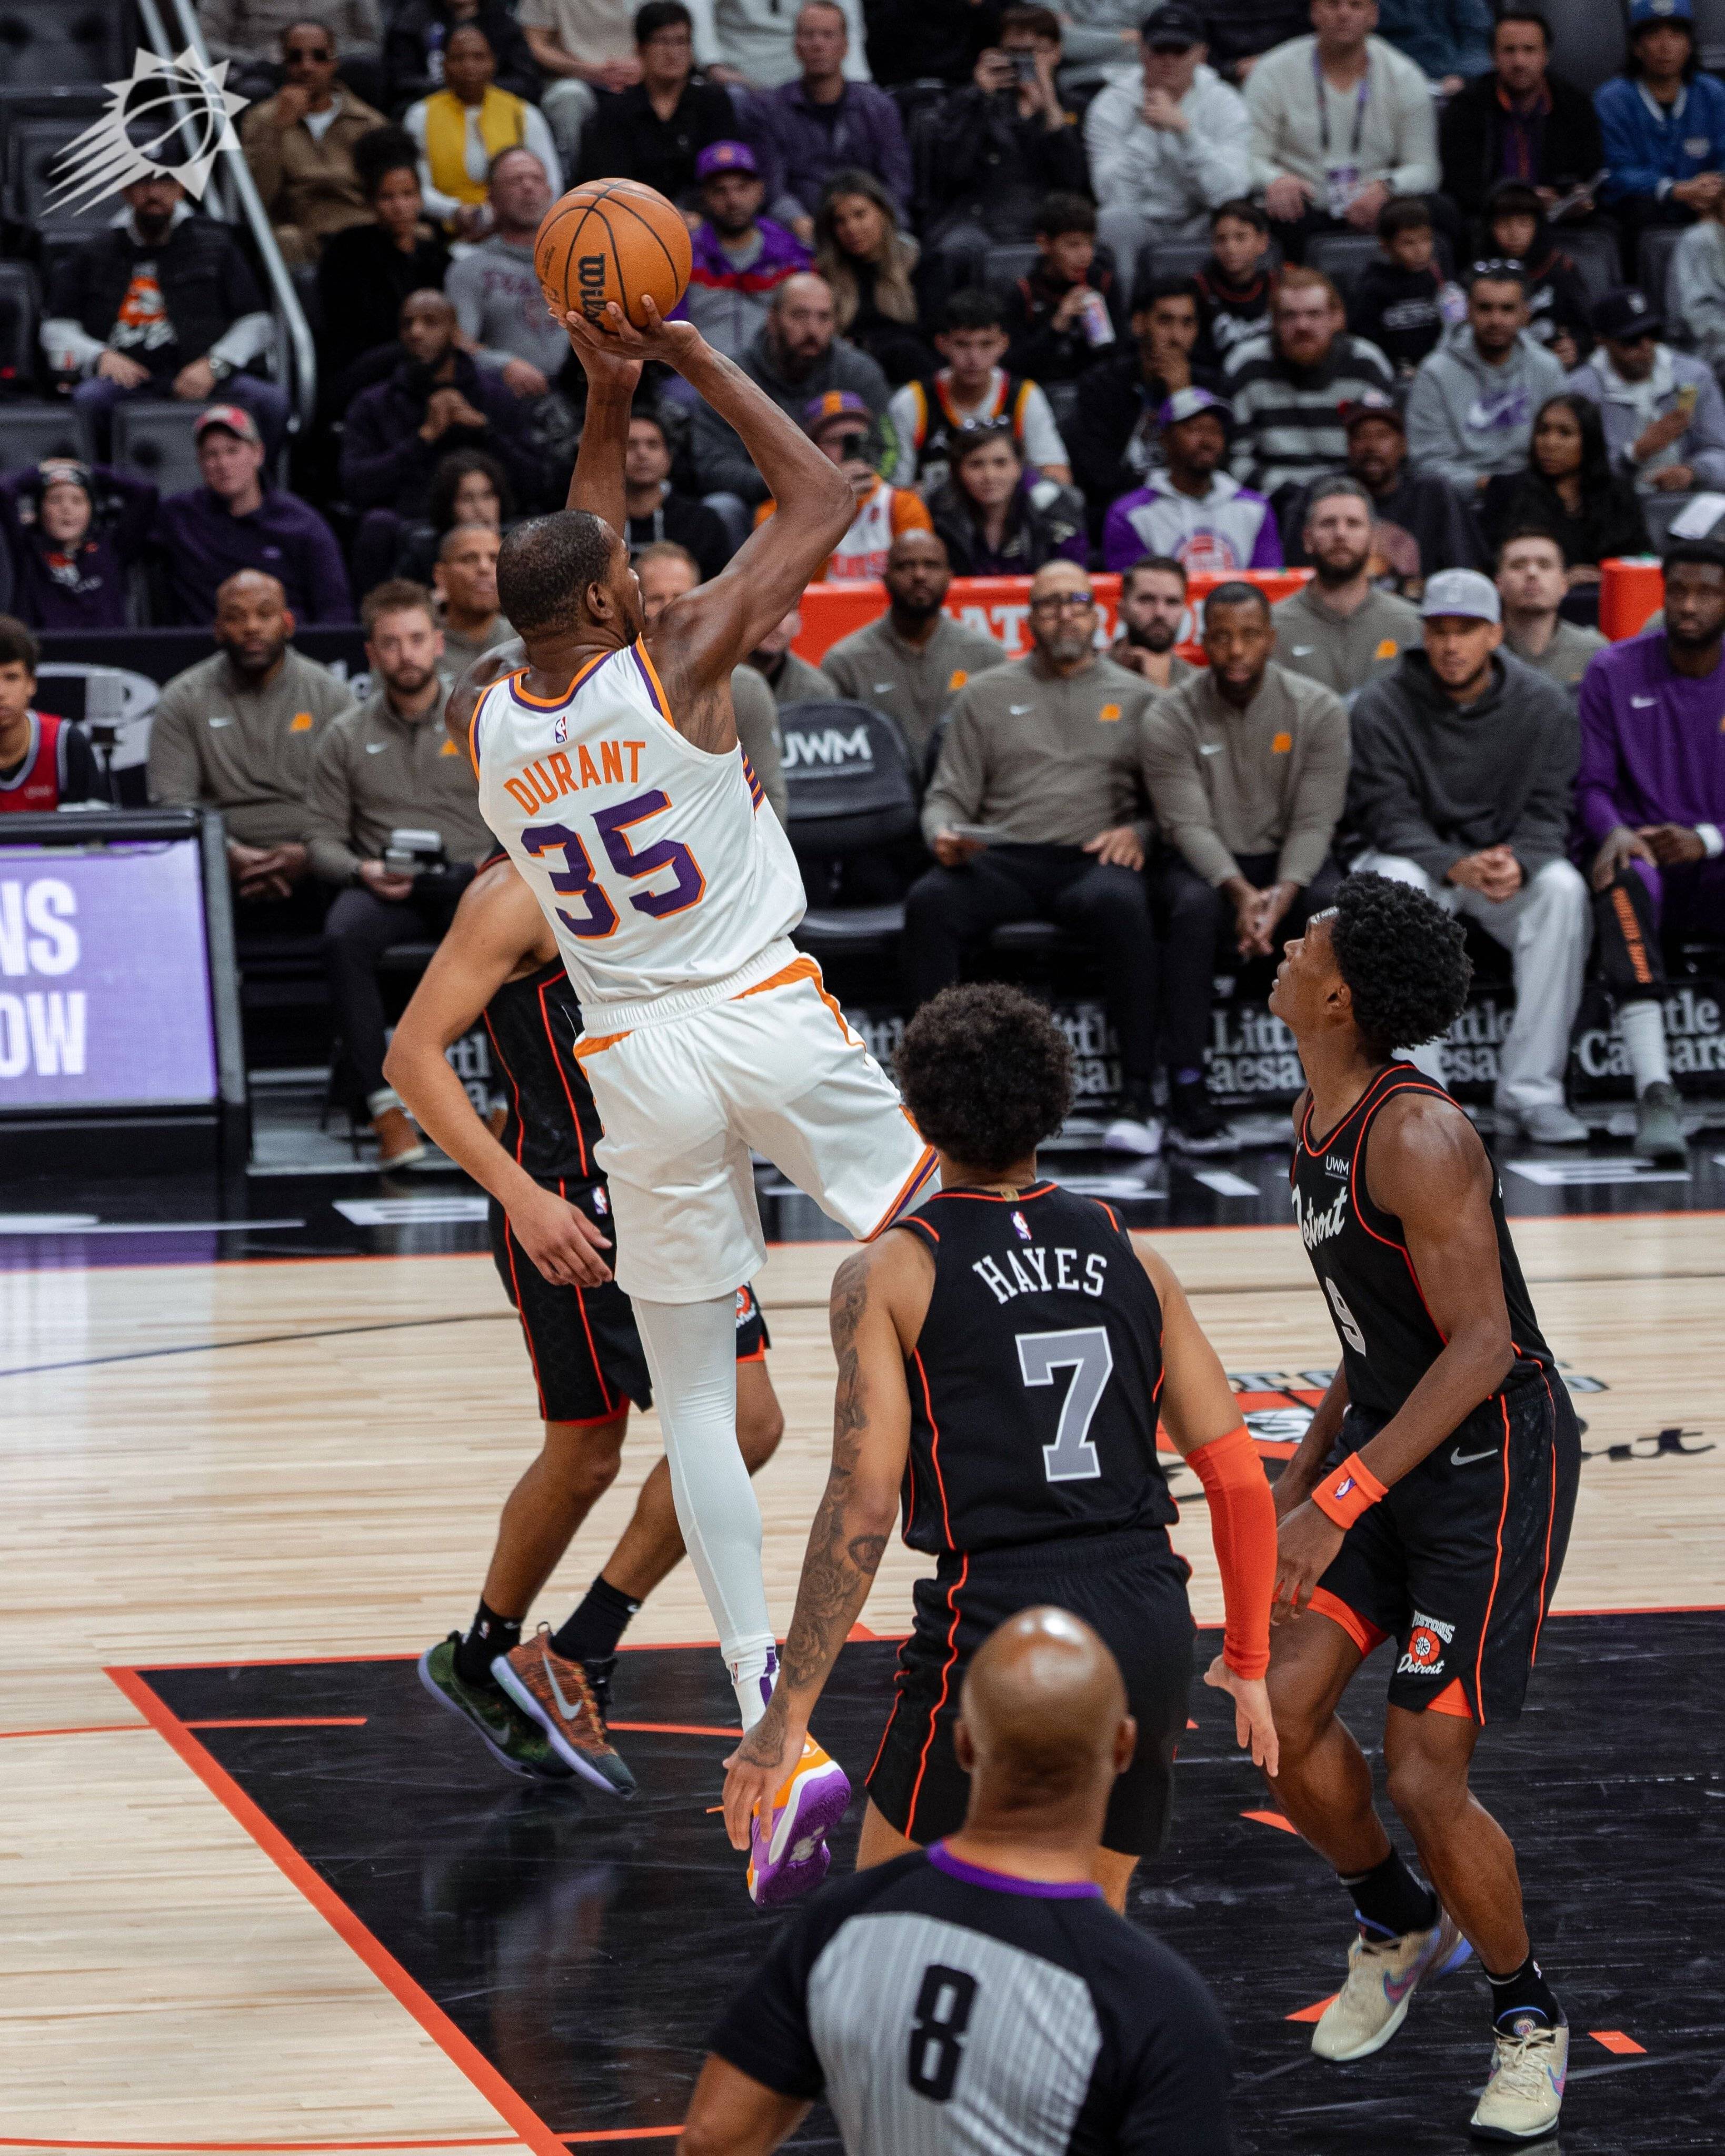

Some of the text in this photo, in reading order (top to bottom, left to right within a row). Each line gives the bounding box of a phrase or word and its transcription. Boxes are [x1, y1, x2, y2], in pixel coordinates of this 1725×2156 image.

[578, 253, 606, 331] Wils
[504, 741, 646, 816] DURANT
[521, 790, 707, 940] 35
[1212, 1008, 1297, 1053] Litt
[1325, 1155, 1350, 1176] UWM
[972, 1246, 1108, 1305] HAYES
[1325, 1276, 1367, 1357] 9
[1015, 1325, 1113, 1483] 7
[1397, 1653, 1445, 1675] Detroit
[1411, 1610, 1455, 1644] PISTONS
[908, 1964, 979, 2102] 8
